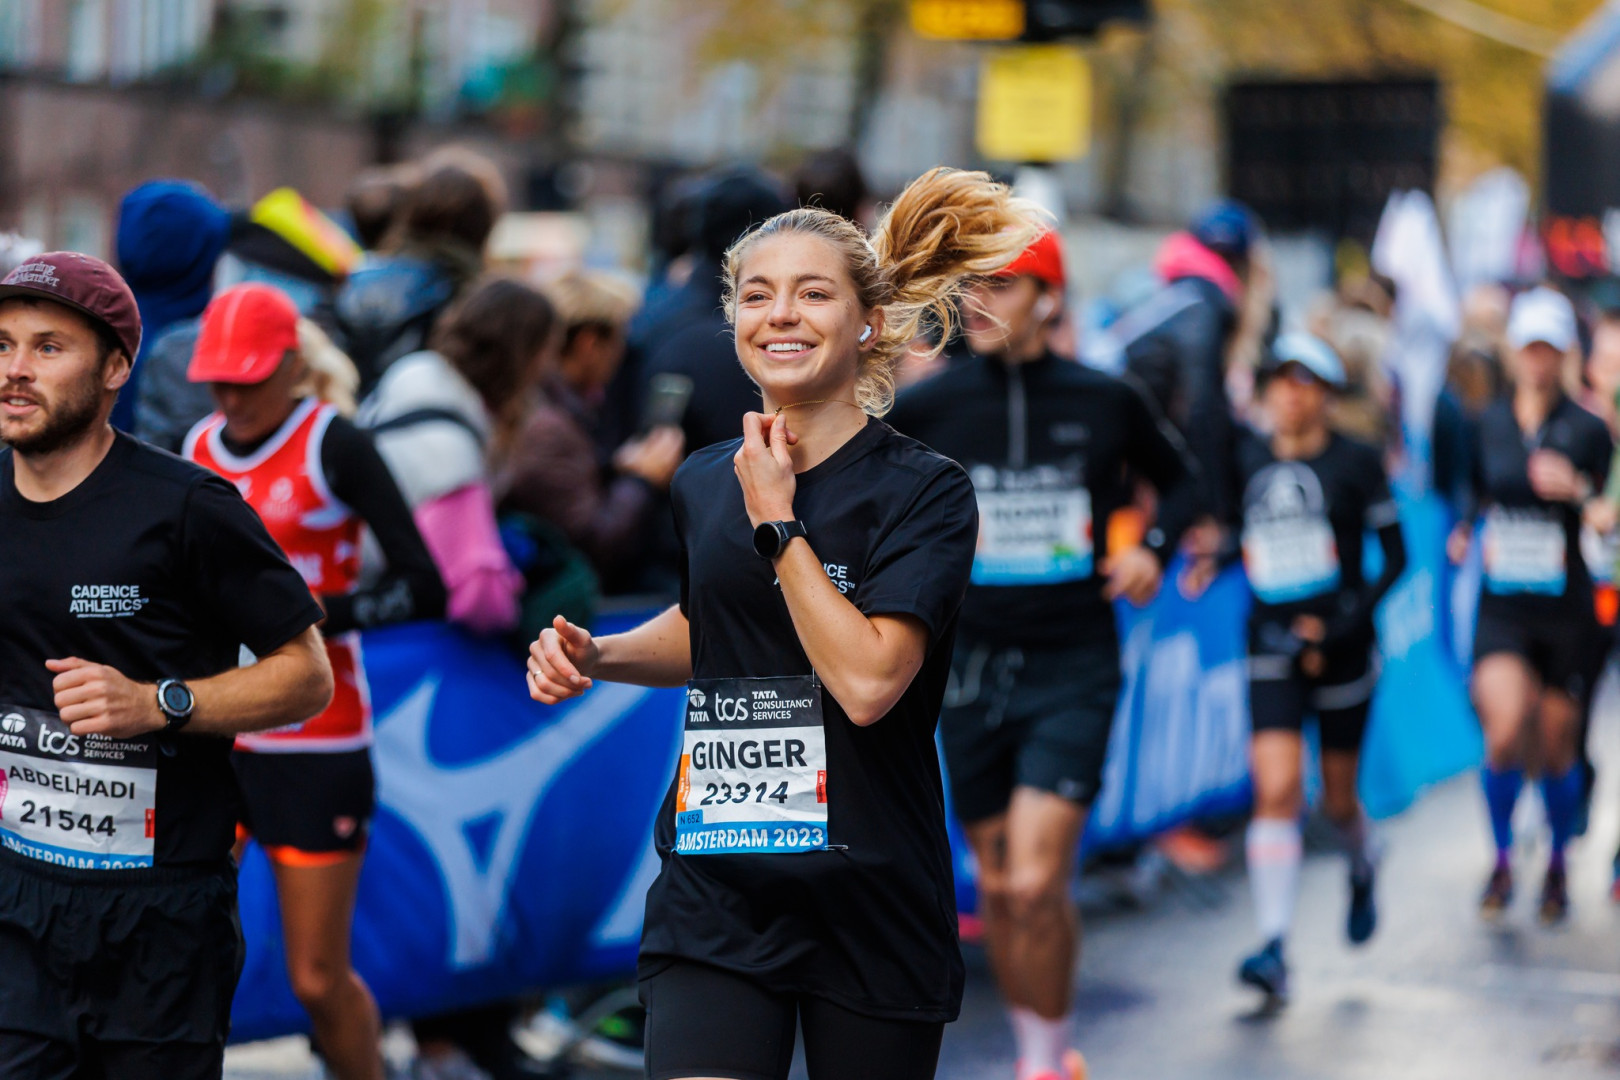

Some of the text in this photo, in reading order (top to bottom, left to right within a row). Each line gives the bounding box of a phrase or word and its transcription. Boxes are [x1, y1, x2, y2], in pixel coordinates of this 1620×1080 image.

[71, 584, 140, 599] CADENCE
[69, 598, 143, 613] ATHLETICS
[752, 690, 778, 700] TATA
[714, 692, 749, 722] tcs
[752, 699, 813, 710] CONSULTANCY
[689, 710, 710, 723] TATA
[752, 710, 792, 721] SERVICES
[37, 723, 81, 756] tcs
[84, 740, 149, 753] CONSULTANCY
[84, 748, 126, 760] SERVICES
[692, 739, 808, 771] GINGER
[9, 765, 135, 800] ABDELHADI
[700, 781, 789, 806] 23314
[20, 799, 117, 837] 21544
[680, 813, 700, 825] N 652
[676, 827, 824, 851] AMSTERDAM 2023
